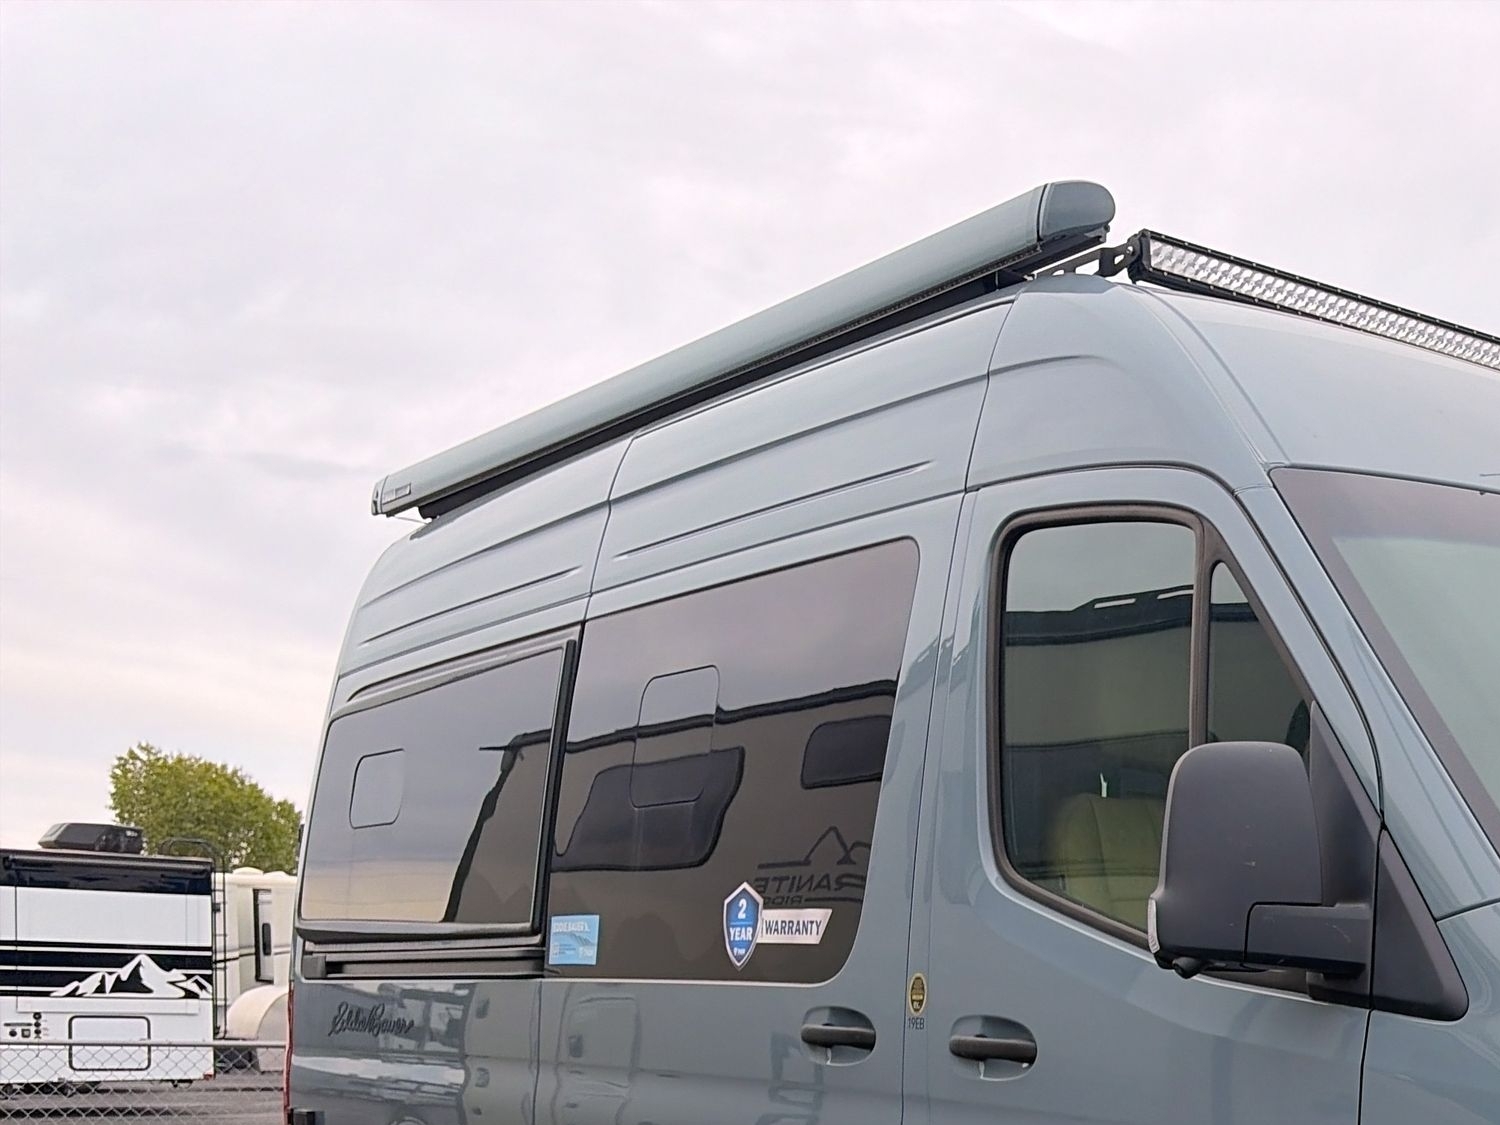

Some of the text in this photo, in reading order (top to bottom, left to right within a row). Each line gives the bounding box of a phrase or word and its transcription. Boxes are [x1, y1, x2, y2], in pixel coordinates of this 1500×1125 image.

[737, 898, 747, 919] 2
[729, 926, 753, 941] YEAR
[764, 919, 822, 936] WARRANTY
